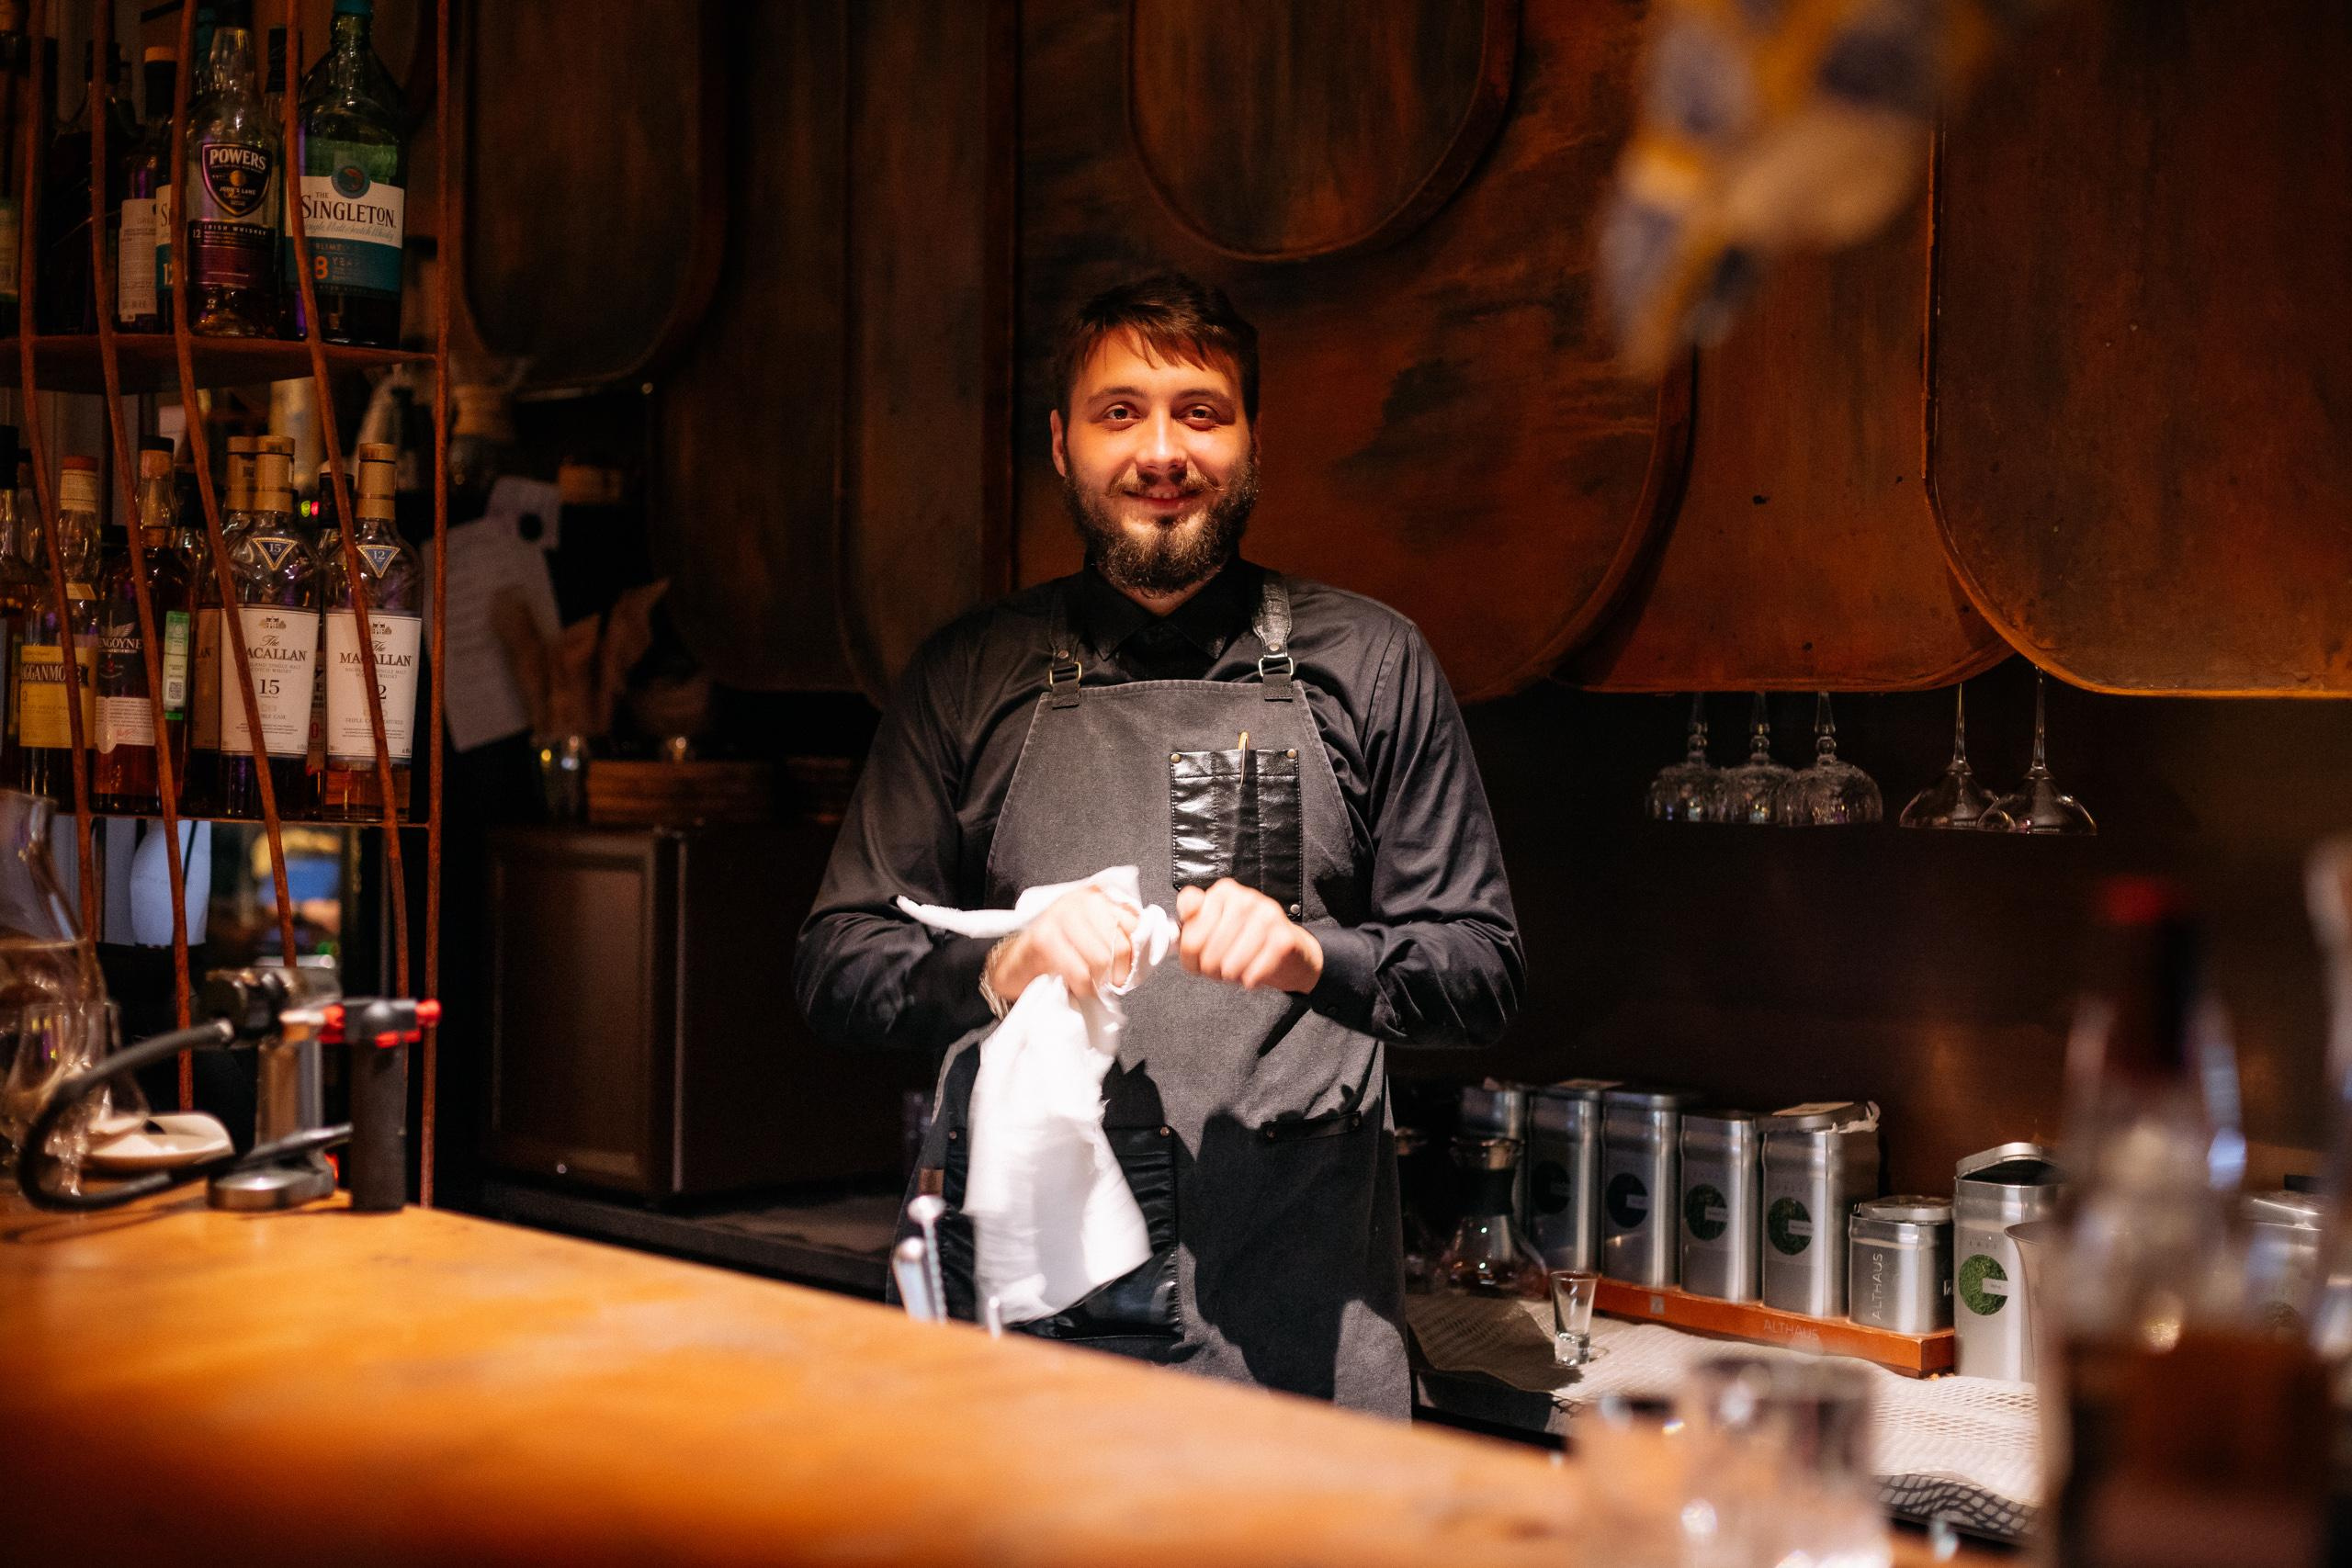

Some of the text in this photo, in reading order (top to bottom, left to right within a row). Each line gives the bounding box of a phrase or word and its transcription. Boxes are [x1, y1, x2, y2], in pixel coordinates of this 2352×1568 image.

[209, 148, 266, 171] POWERS
[301, 195, 395, 228] SINGLETON
[192, 228, 202, 239] 12
[269, 542, 283, 553] 15
[372, 550, 386, 560] 12
[262, 636, 279, 647] The
[372, 641, 386, 651] The
[246, 648, 306, 661] ACALLAN
[340, 653, 412, 666] MAALLAN
[259, 679, 279, 694] 15
[1871, 1252, 1883, 1322] ALTHAUS
[1763, 1319, 1820, 1341] ALTHAUS
